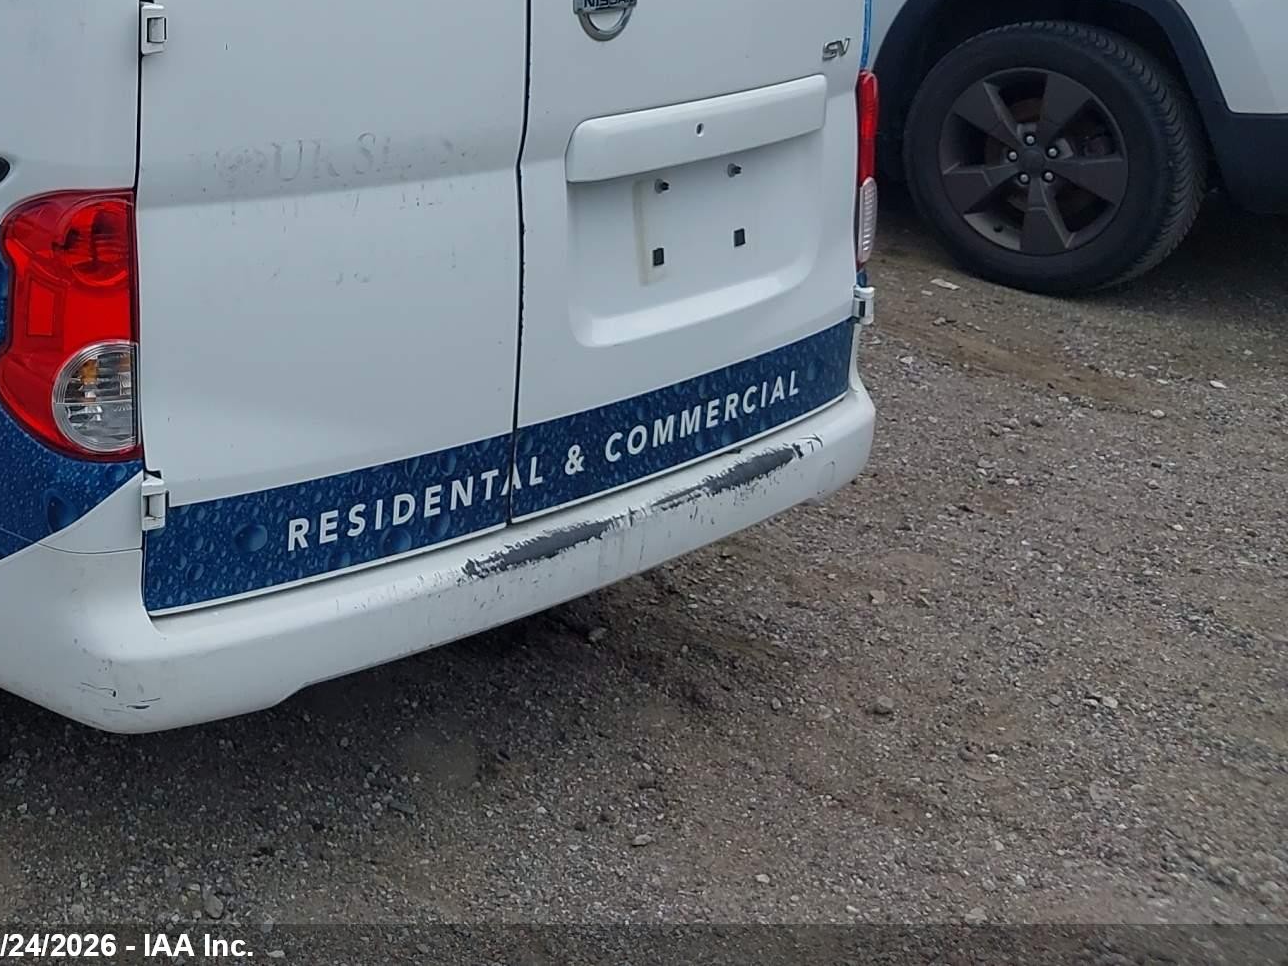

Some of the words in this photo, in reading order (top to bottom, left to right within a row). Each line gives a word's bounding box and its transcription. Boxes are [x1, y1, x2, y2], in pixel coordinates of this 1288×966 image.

[822, 37, 850, 61] SV
[563, 443, 586, 476] &
[604, 369, 801, 463] COMMERCIAL
